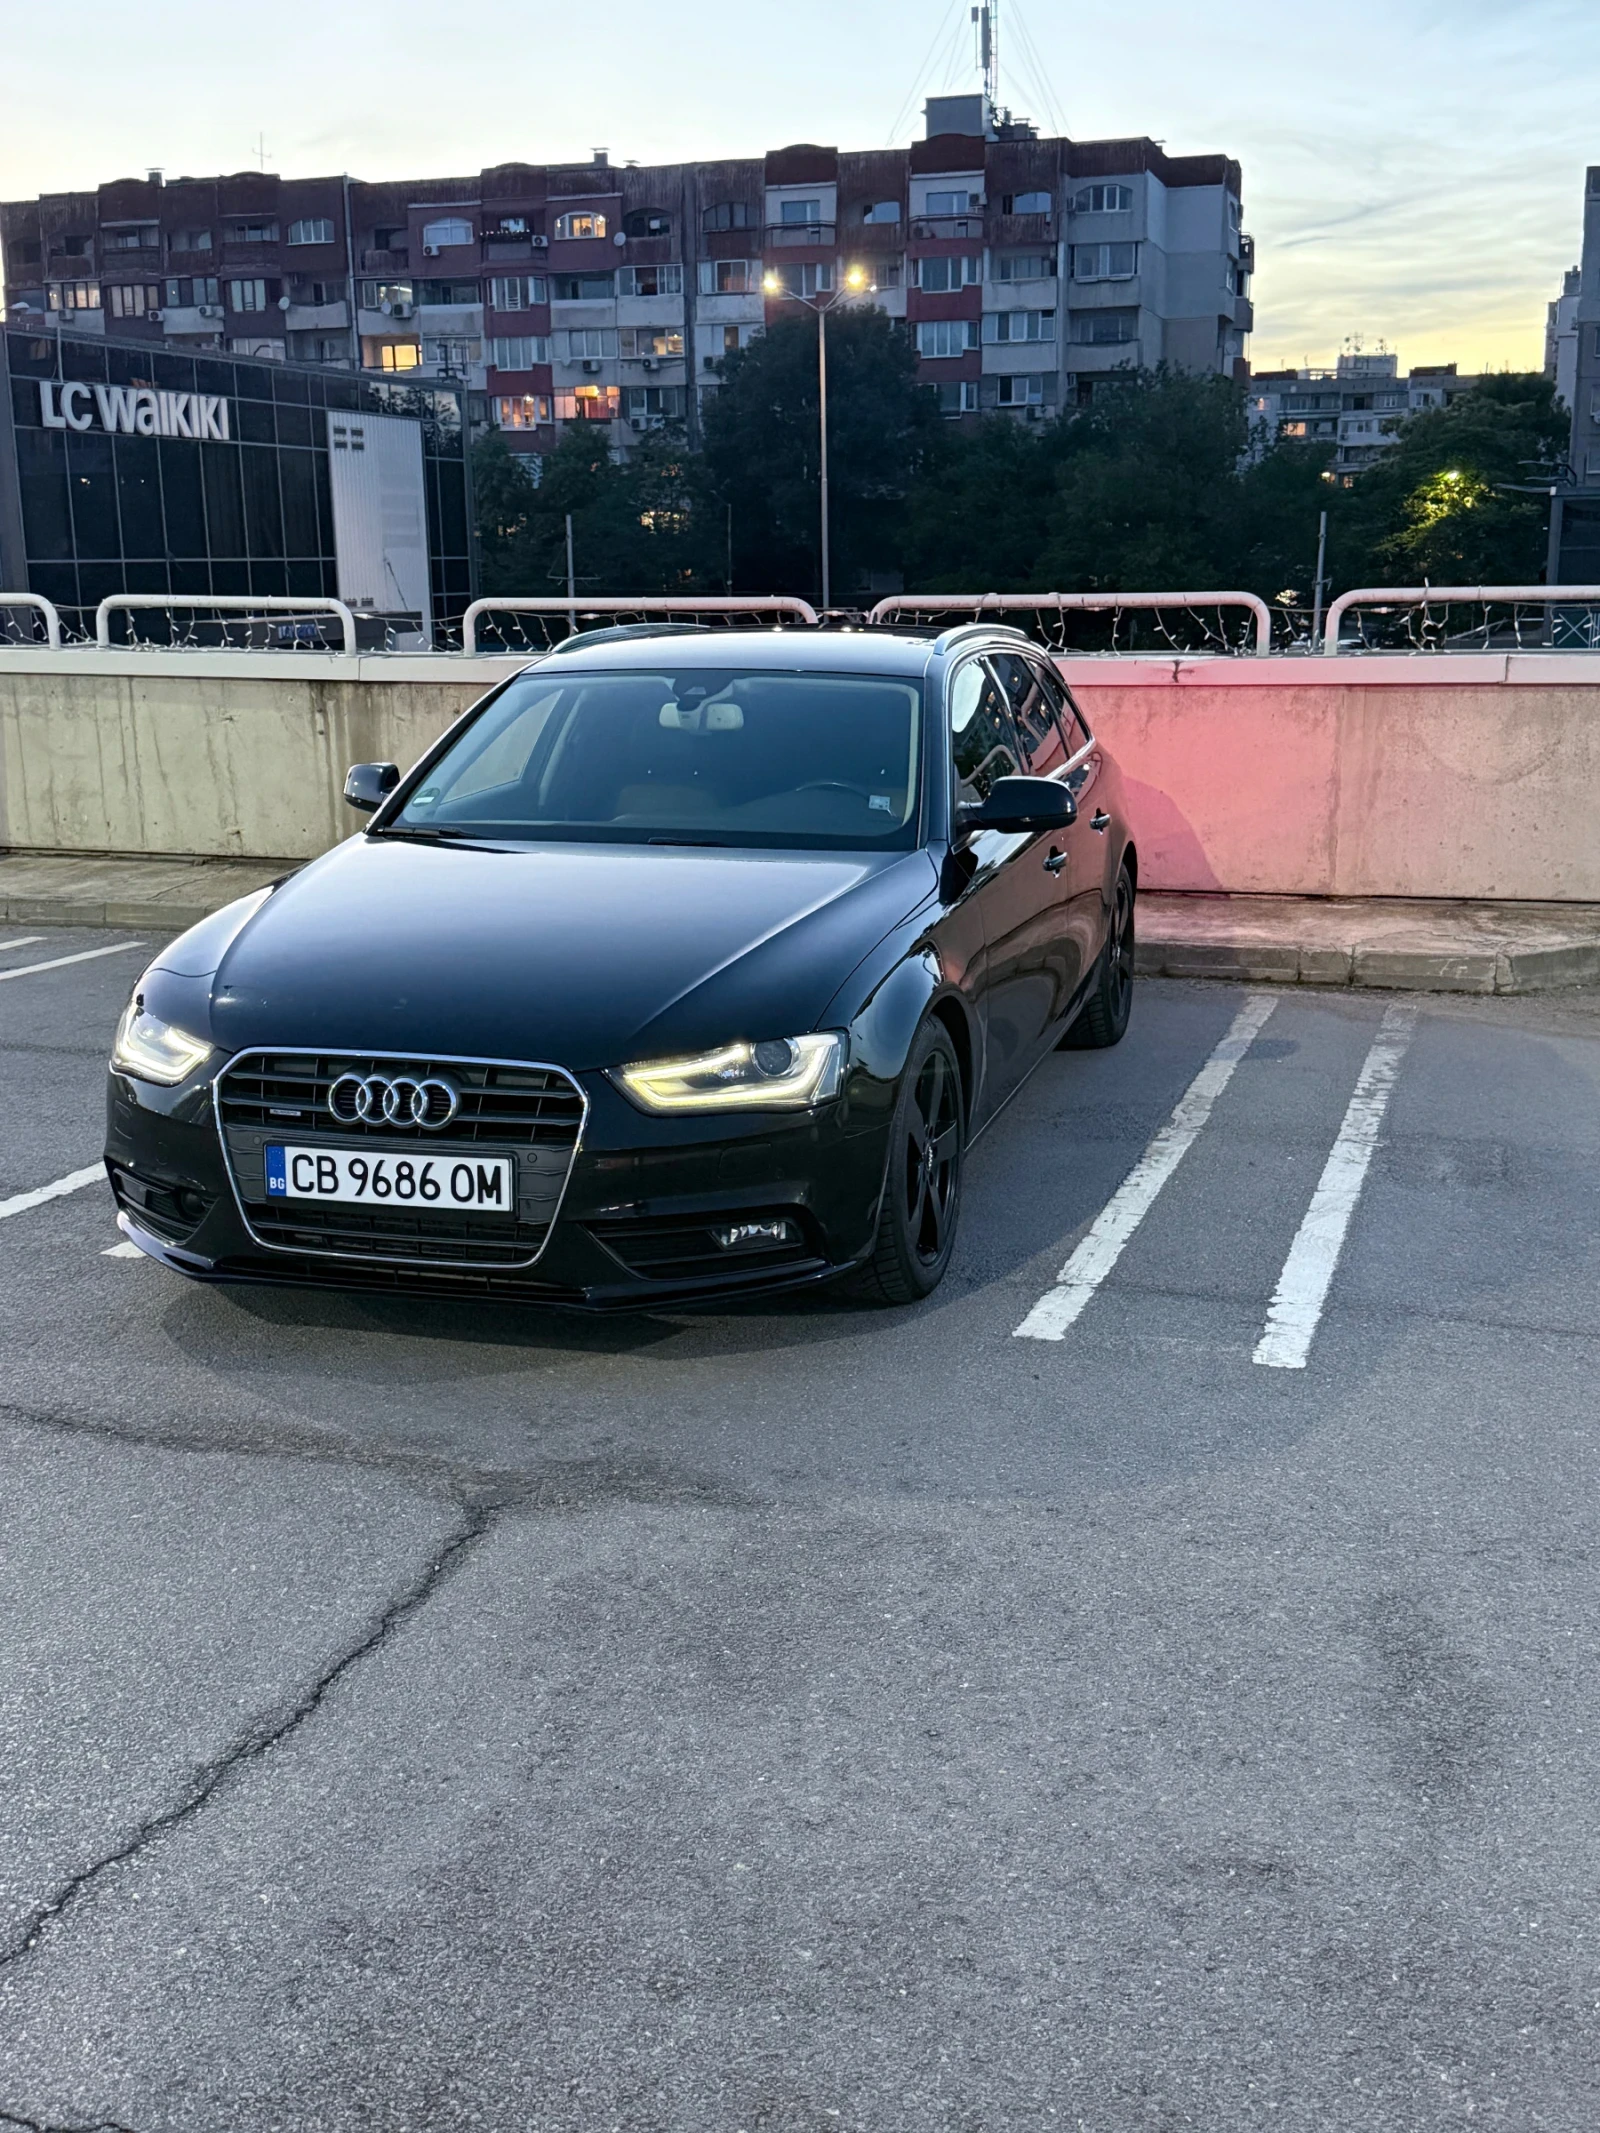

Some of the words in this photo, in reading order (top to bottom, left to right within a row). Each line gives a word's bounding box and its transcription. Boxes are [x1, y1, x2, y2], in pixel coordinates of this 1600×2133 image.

[39, 381, 93, 431] LC
[269, 1177, 285, 1190] BG
[292, 1154, 339, 1194] CB
[348, 1158, 441, 1201] 9686
[450, 1163, 502, 1205] OM
